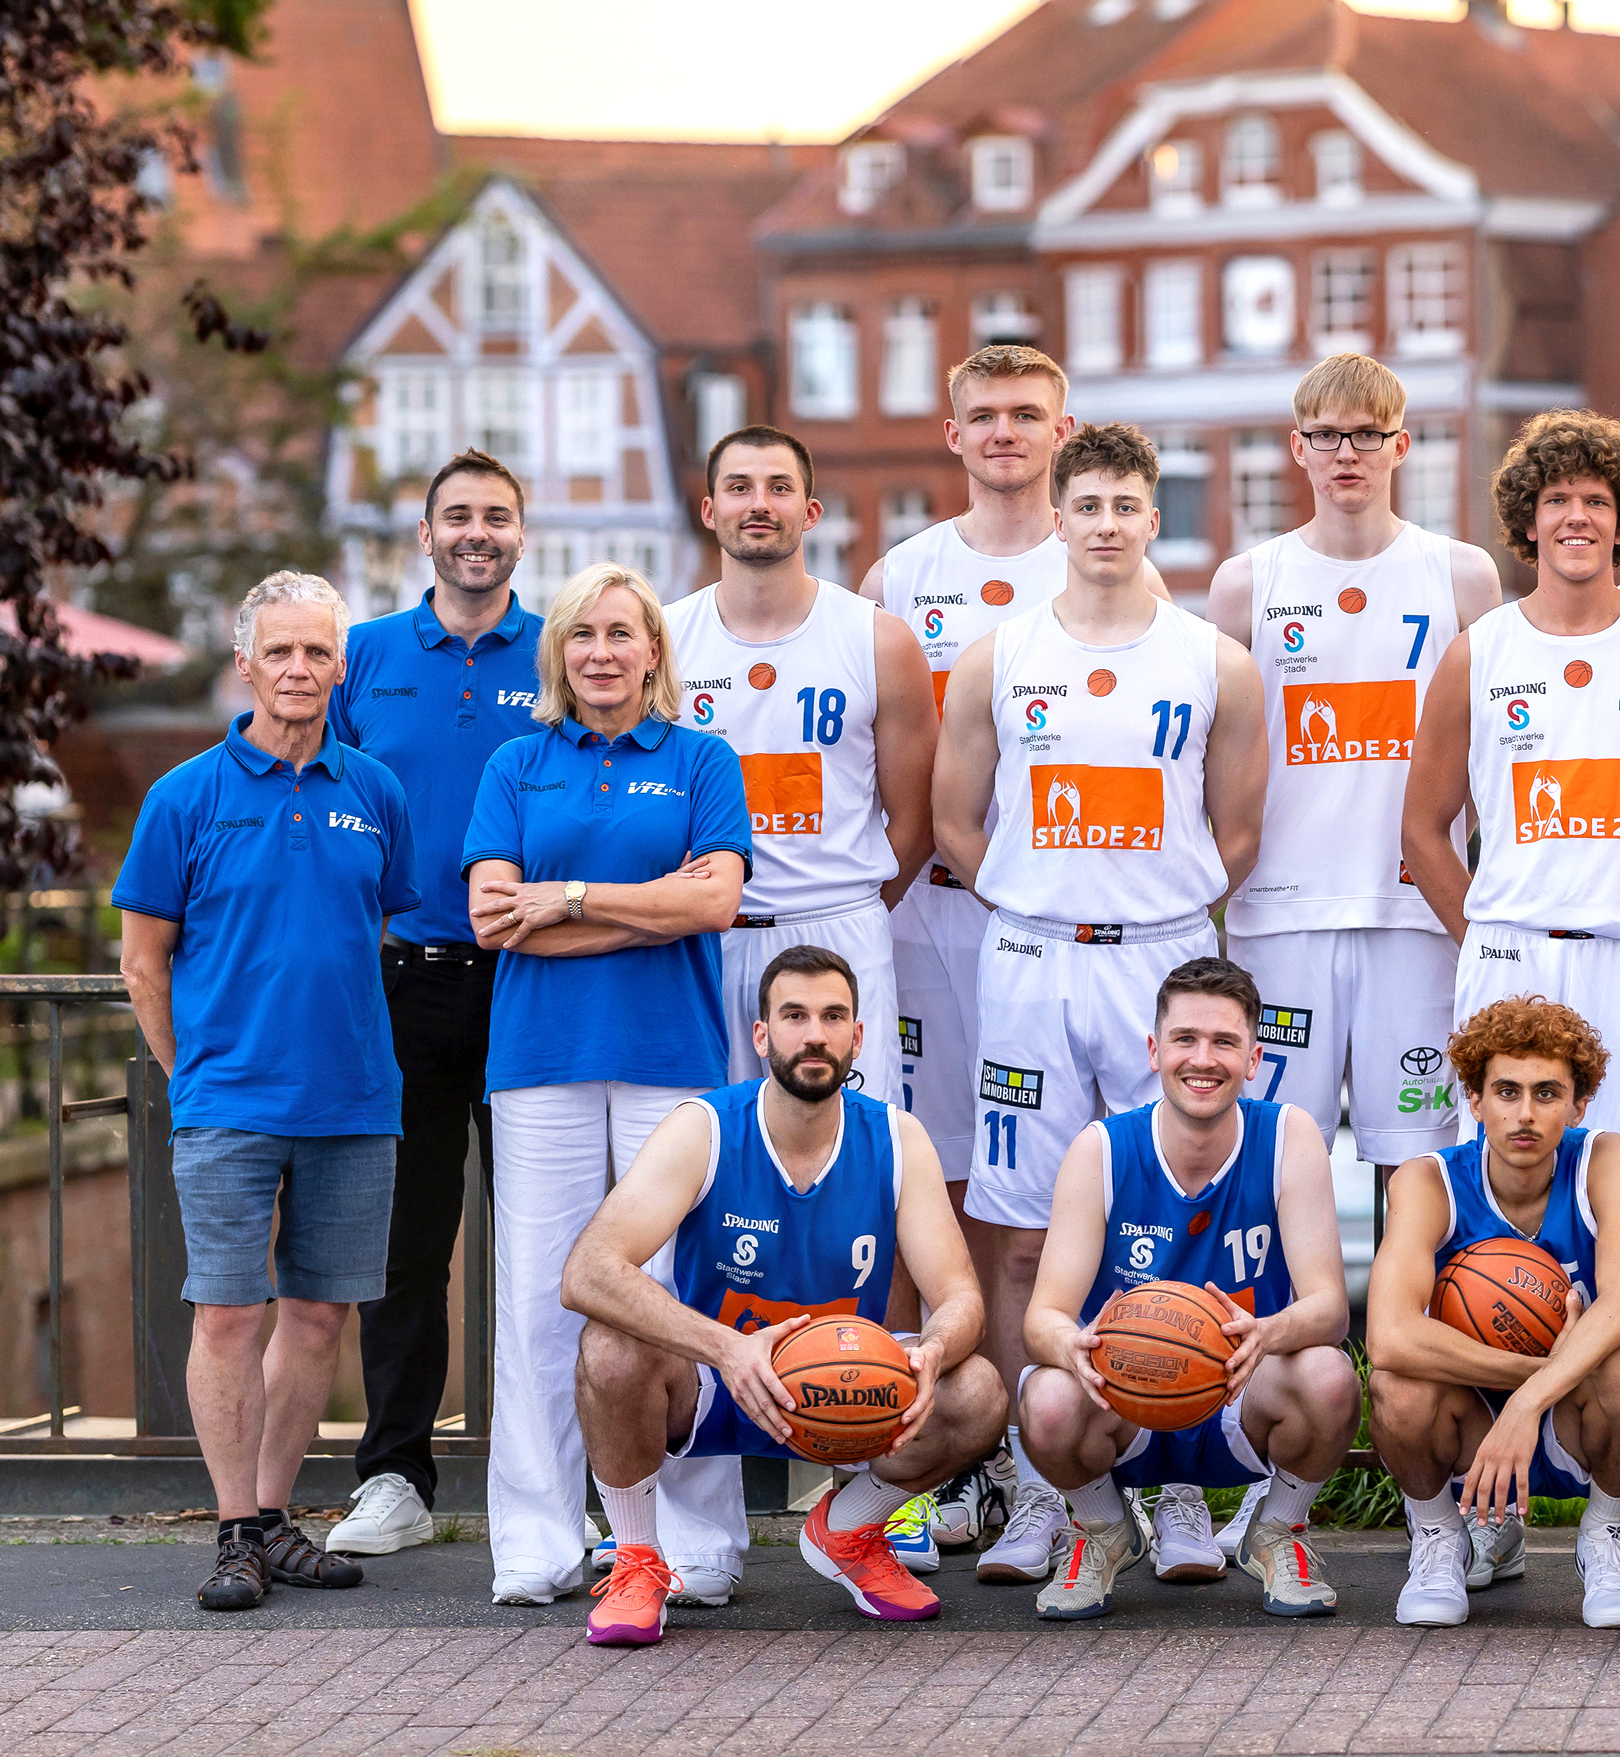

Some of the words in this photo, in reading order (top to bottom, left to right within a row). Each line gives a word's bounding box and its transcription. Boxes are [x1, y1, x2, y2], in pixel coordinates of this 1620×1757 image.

[914, 593, 964, 609] SPALDING
[1266, 604, 1322, 621] SPALDING
[1402, 615, 1430, 669] 7
[371, 687, 418, 699] SPALDING
[682, 677, 732, 691] PALDING
[1012, 685, 1068, 699] SPALDING
[1490, 681, 1547, 701] SPALDING
[796, 687, 847, 746] 18
[1019, 733, 1062, 745] Stadtwerke
[1151, 700, 1192, 761] 11
[1290, 739, 1380, 763] STADE
[1387, 739, 1414, 758] 21
[518, 780, 566, 792] SPALDING
[215, 816, 264, 833] SPALDING
[792, 812, 820, 831] 21
[1519, 817, 1606, 842] STADE
[1035, 825, 1125, 848] STADE
[1130, 826, 1161, 848] 21
[996, 937, 1043, 959] SPALDING
[1401, 1075, 1445, 1086] Autohaus
[984, 1110, 1018, 1170] 11
[722, 1212, 779, 1234] SPALDING
[1119, 1222, 1173, 1243] SPALDING
[851, 1234, 877, 1290] 9
[1223, 1224, 1272, 1283] 19
[715, 1261, 764, 1278] Stadtwerke
[725, 1271, 751, 1285] Stade
[1114, 1265, 1160, 1282] Stadtwerke
[1108, 1302, 1206, 1341] SPALDING
[1104, 1344, 1189, 1375] PRECISION
[800, 1383, 898, 1410] SPALDING
